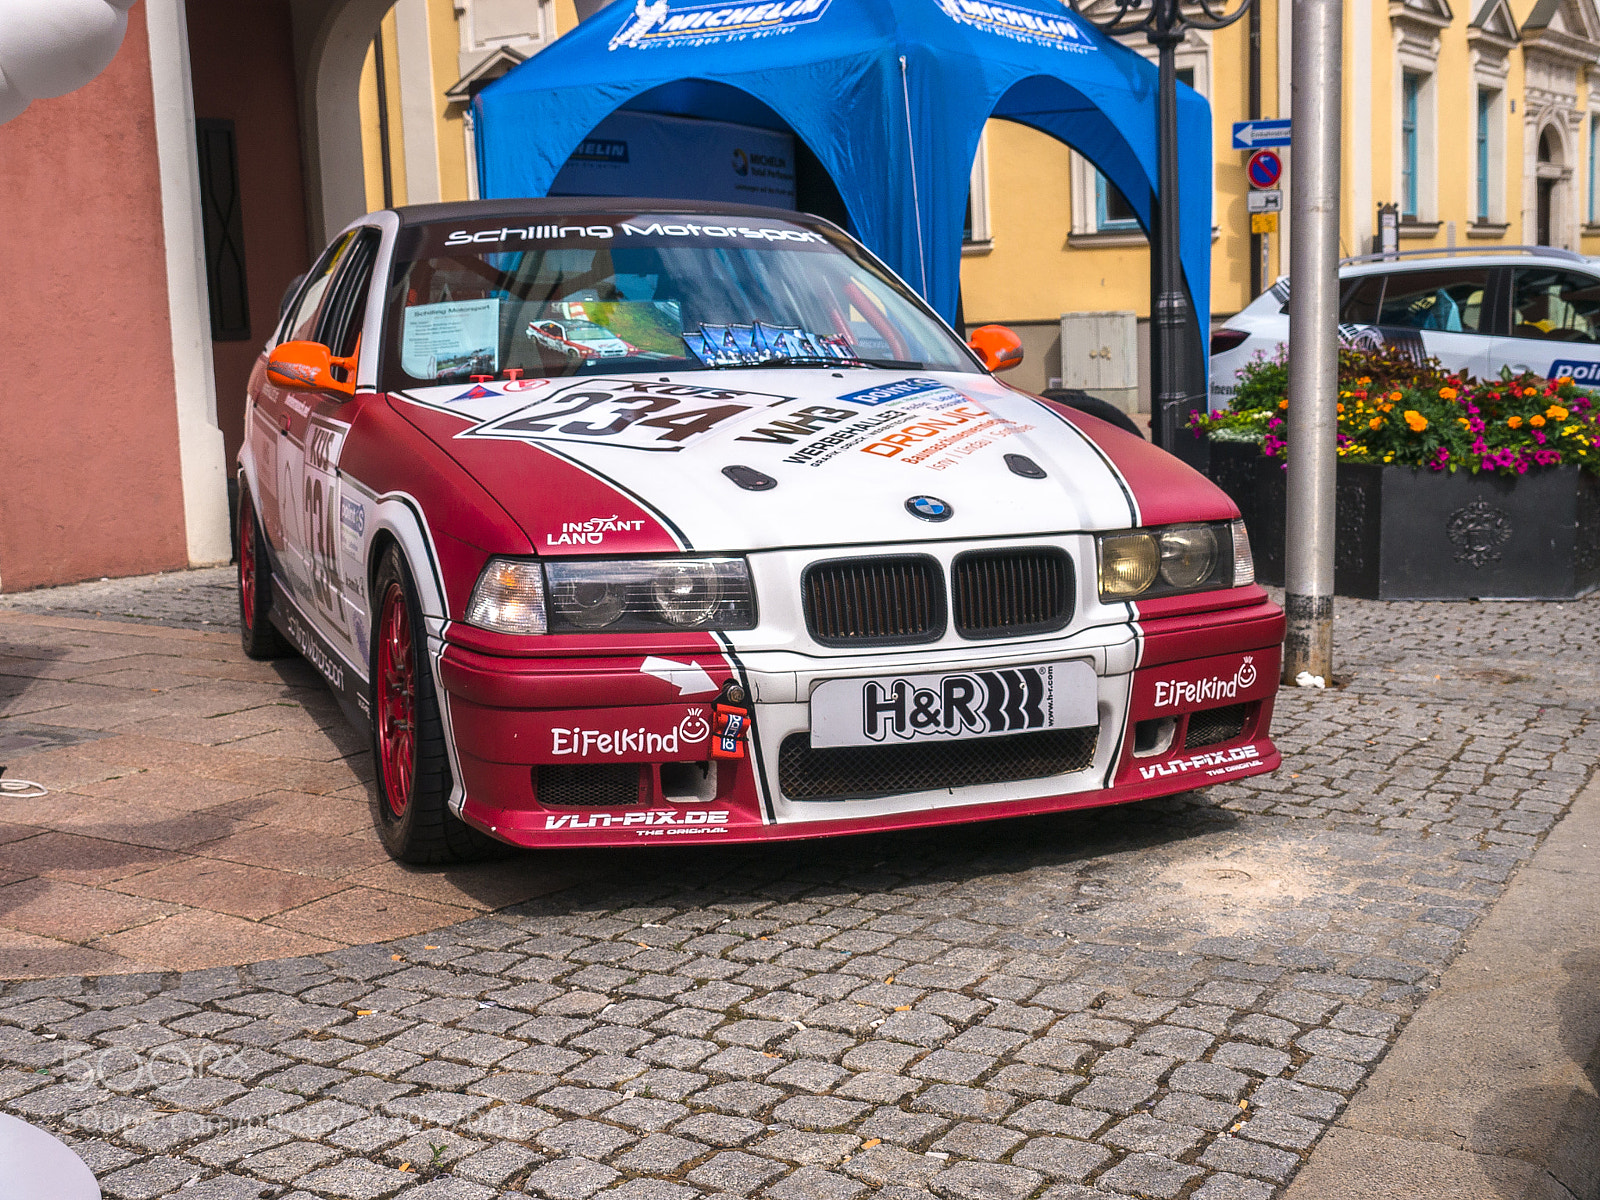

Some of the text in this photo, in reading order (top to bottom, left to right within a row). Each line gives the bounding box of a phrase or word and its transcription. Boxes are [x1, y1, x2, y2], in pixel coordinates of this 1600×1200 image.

[659, 0, 822, 31] MICHELIN
[958, 0, 1078, 38] MICHELIN
[444, 223, 829, 247] Schilling Motorsport
[492, 392, 753, 442] 234
[562, 514, 645, 533] INSTANT
[546, 532, 603, 546] LAND
[863, 674, 987, 742] H&R
[1046, 666, 1054, 727] www.h-r.com
[1205, 759, 1264, 777] THE ORIGINAL
[666, 827, 729, 835] ORIGINAL
